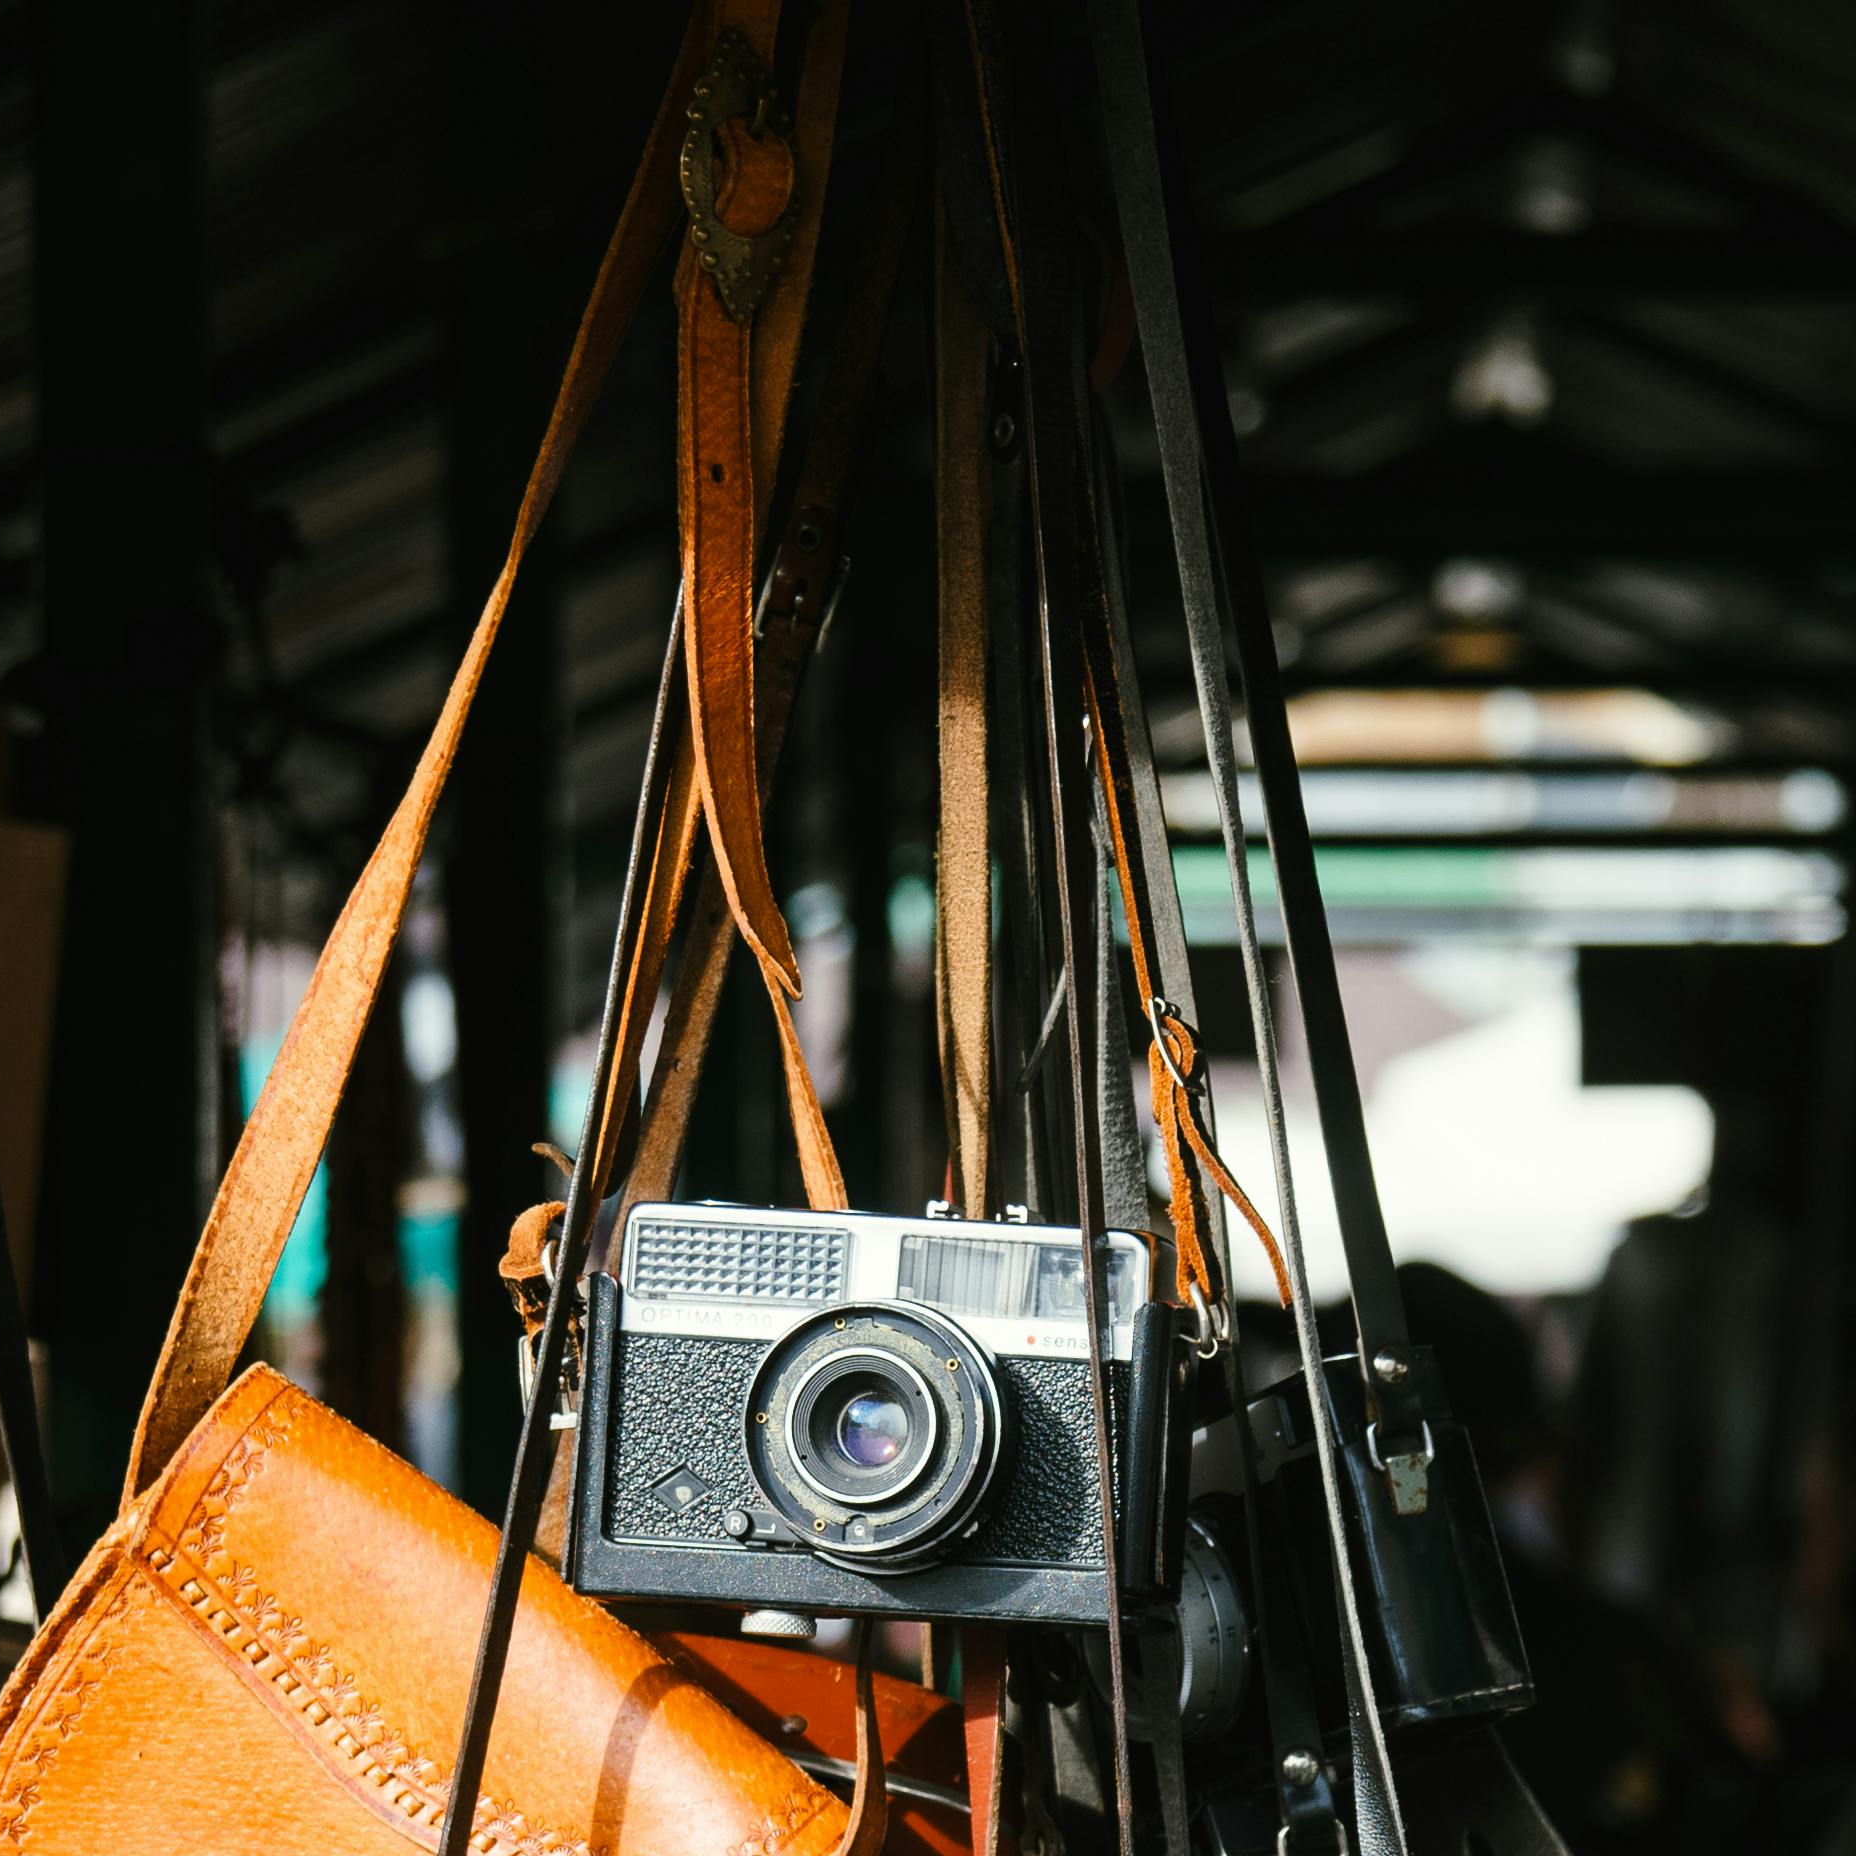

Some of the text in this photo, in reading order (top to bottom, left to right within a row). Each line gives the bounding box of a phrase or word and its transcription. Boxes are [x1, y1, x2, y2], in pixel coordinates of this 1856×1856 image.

[641, 1306, 773, 1329] OPTIMA 200
[730, 1516, 741, 1531] R
